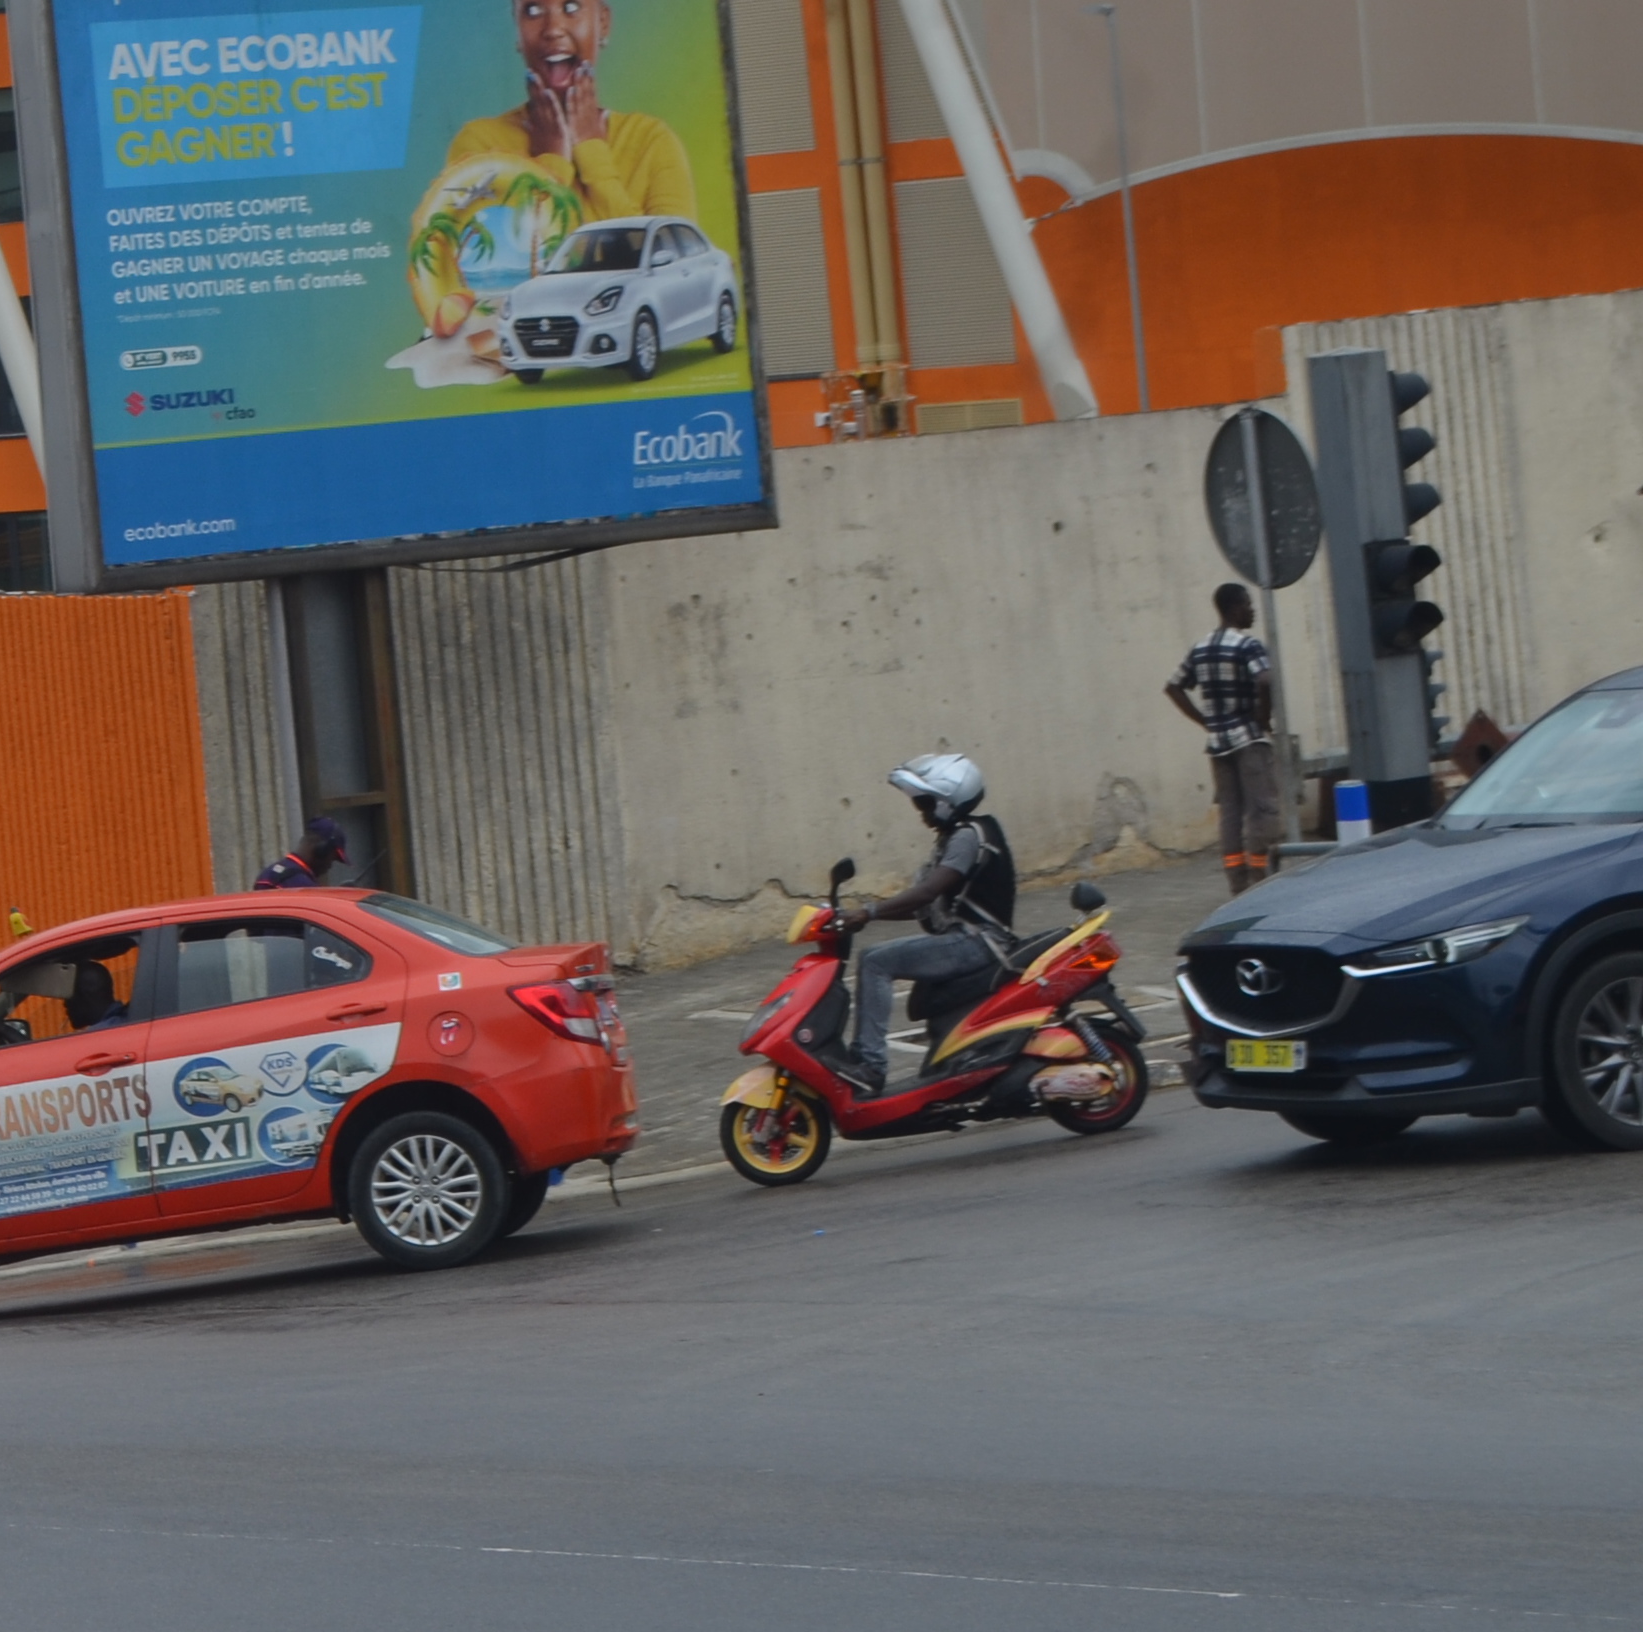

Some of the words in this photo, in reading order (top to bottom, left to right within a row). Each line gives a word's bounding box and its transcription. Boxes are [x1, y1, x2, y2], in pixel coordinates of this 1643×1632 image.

[109, 39, 211, 80] AVEC
[218, 29, 397, 73] ECOBANK
[112, 76, 284, 123] DÉPOSER
[290, 72, 387, 112] C'EST
[107, 206, 175, 226] OUVREZ
[179, 201, 234, 220] VOTRE
[237, 195, 312, 216] COMPTE,
[109, 232, 165, 252] FAITES
[170, 230, 203, 248] DES
[206, 222, 271, 244] DÉPÔTS
[275, 225, 293, 240] et
[296, 222, 347, 238] tentez
[350, 219, 372, 234] de
[111, 257, 184, 279] GAGNER
[188, 255, 213, 272] UN
[215, 249, 285, 270] VOYAGE
[288, 247, 348, 267] chaque
[352, 242, 391, 260] mois
[114, 290, 132, 305] et
[136, 284, 170, 303] UNE
[172, 278, 246, 300] VOITURE
[249, 279, 270, 294] en
[274, 274, 295, 292] fin
[298, 270, 367, 290] d'année.
[149, 388, 235, 411] SUZUKI
[226, 407, 256, 420] cfao
[633, 411, 744, 465] Ecobank
[124, 519, 236, 542] ecobank.com
[267, 1057, 293, 1070] KDS
[137, 1122, 248, 1168] TAXI
